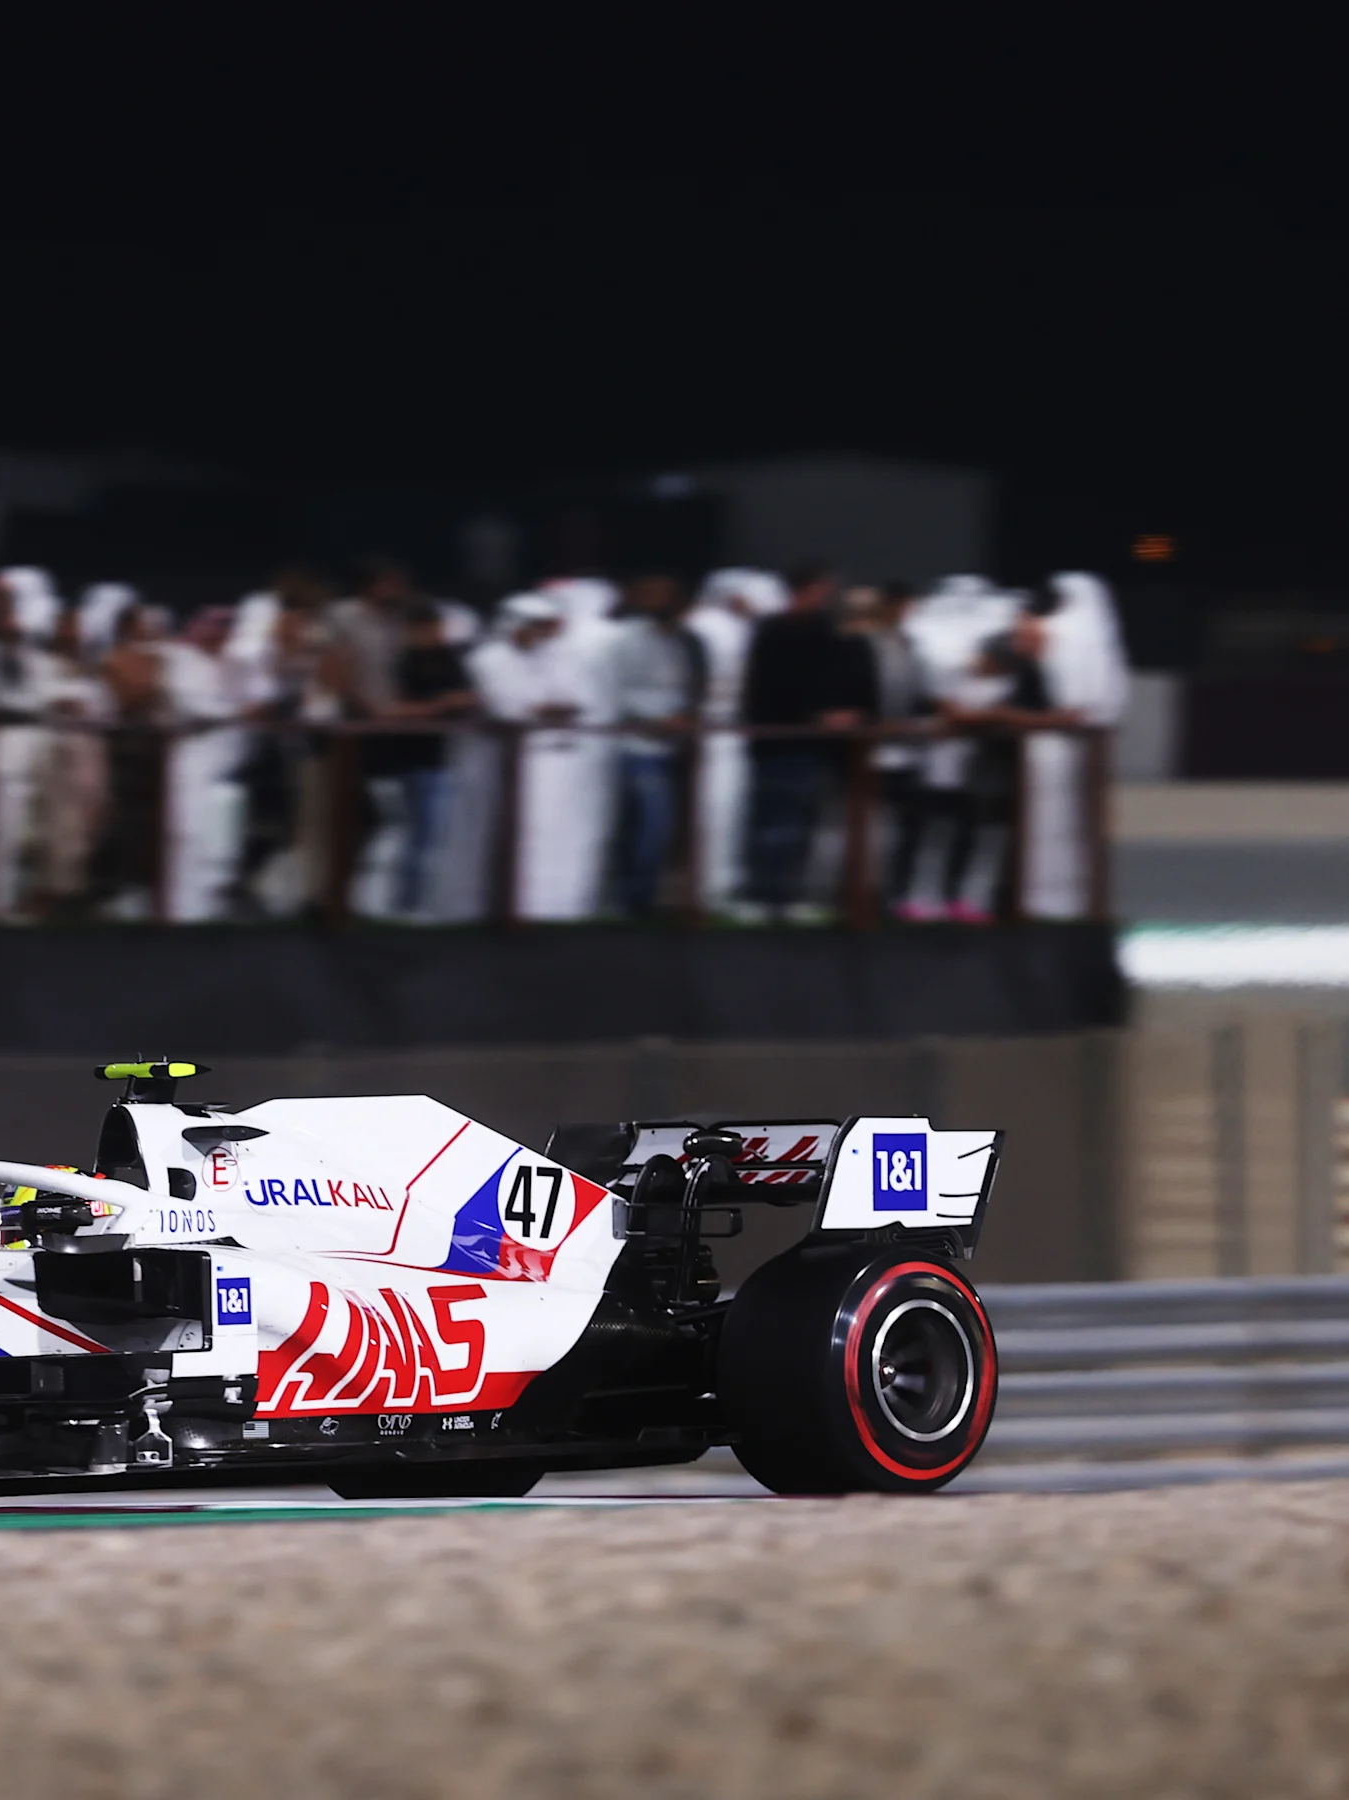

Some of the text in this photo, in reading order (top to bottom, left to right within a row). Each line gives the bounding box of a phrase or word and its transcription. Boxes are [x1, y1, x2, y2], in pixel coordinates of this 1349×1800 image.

[212, 1153, 229, 1185] E
[876, 1150, 923, 1192] 1&1
[244, 1179, 394, 1211] URALKALI
[505, 1166, 563, 1239] 47
[160, 1209, 215, 1233] IONOS
[218, 1287, 249, 1314] 1&1
[254, 1281, 486, 1411] HAAS
